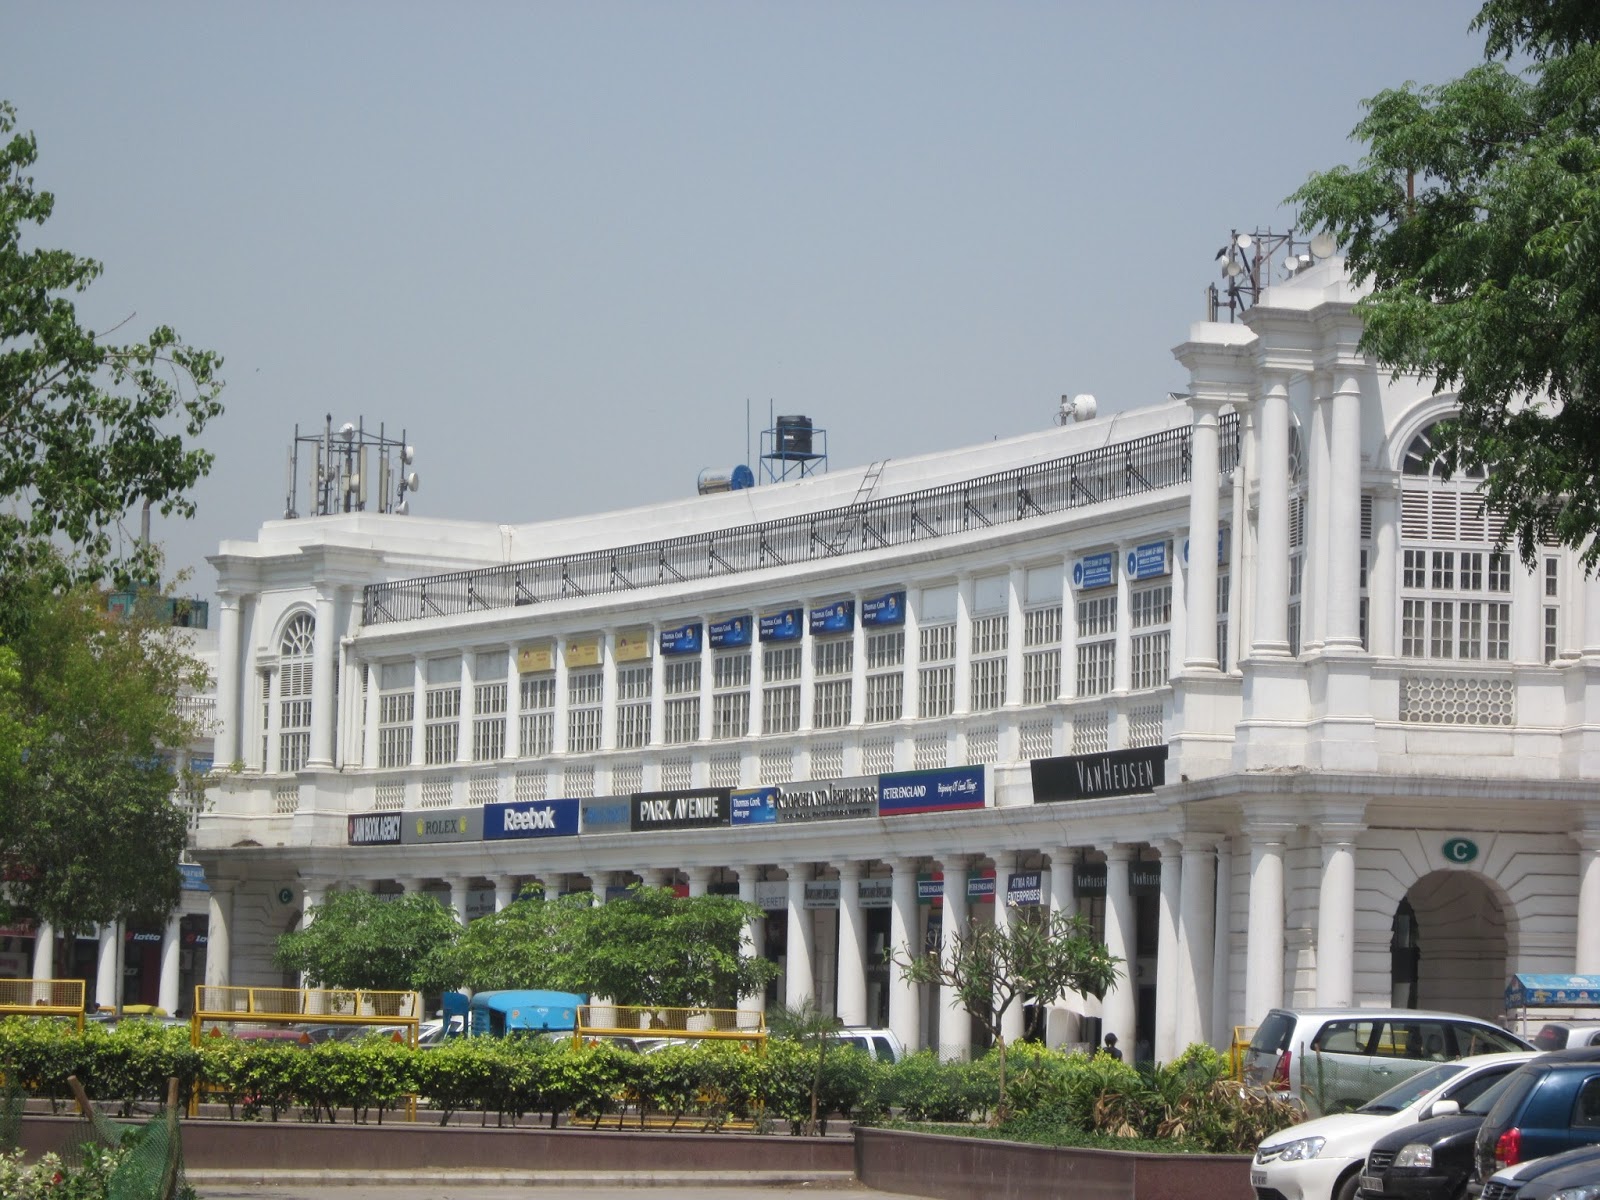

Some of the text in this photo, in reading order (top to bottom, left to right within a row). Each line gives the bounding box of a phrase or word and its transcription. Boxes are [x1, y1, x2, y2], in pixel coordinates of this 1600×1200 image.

[883, 785, 927, 800] PETER ENGLAND
[640, 799, 672, 822] PARK
[673, 796, 719, 819] AVENUE
[733, 796, 761, 808] Thomas Cook
[503, 806, 556, 831] Reebok
[365, 816, 380, 841] BOOK
[380, 815, 401, 841] AGENCY
[425, 819, 458, 835] ROLEX
[1453, 842, 1468, 860] C
[1011, 875, 1038, 889] ATMA RAM
[1007, 889, 1041, 902] ENTERPRISES
